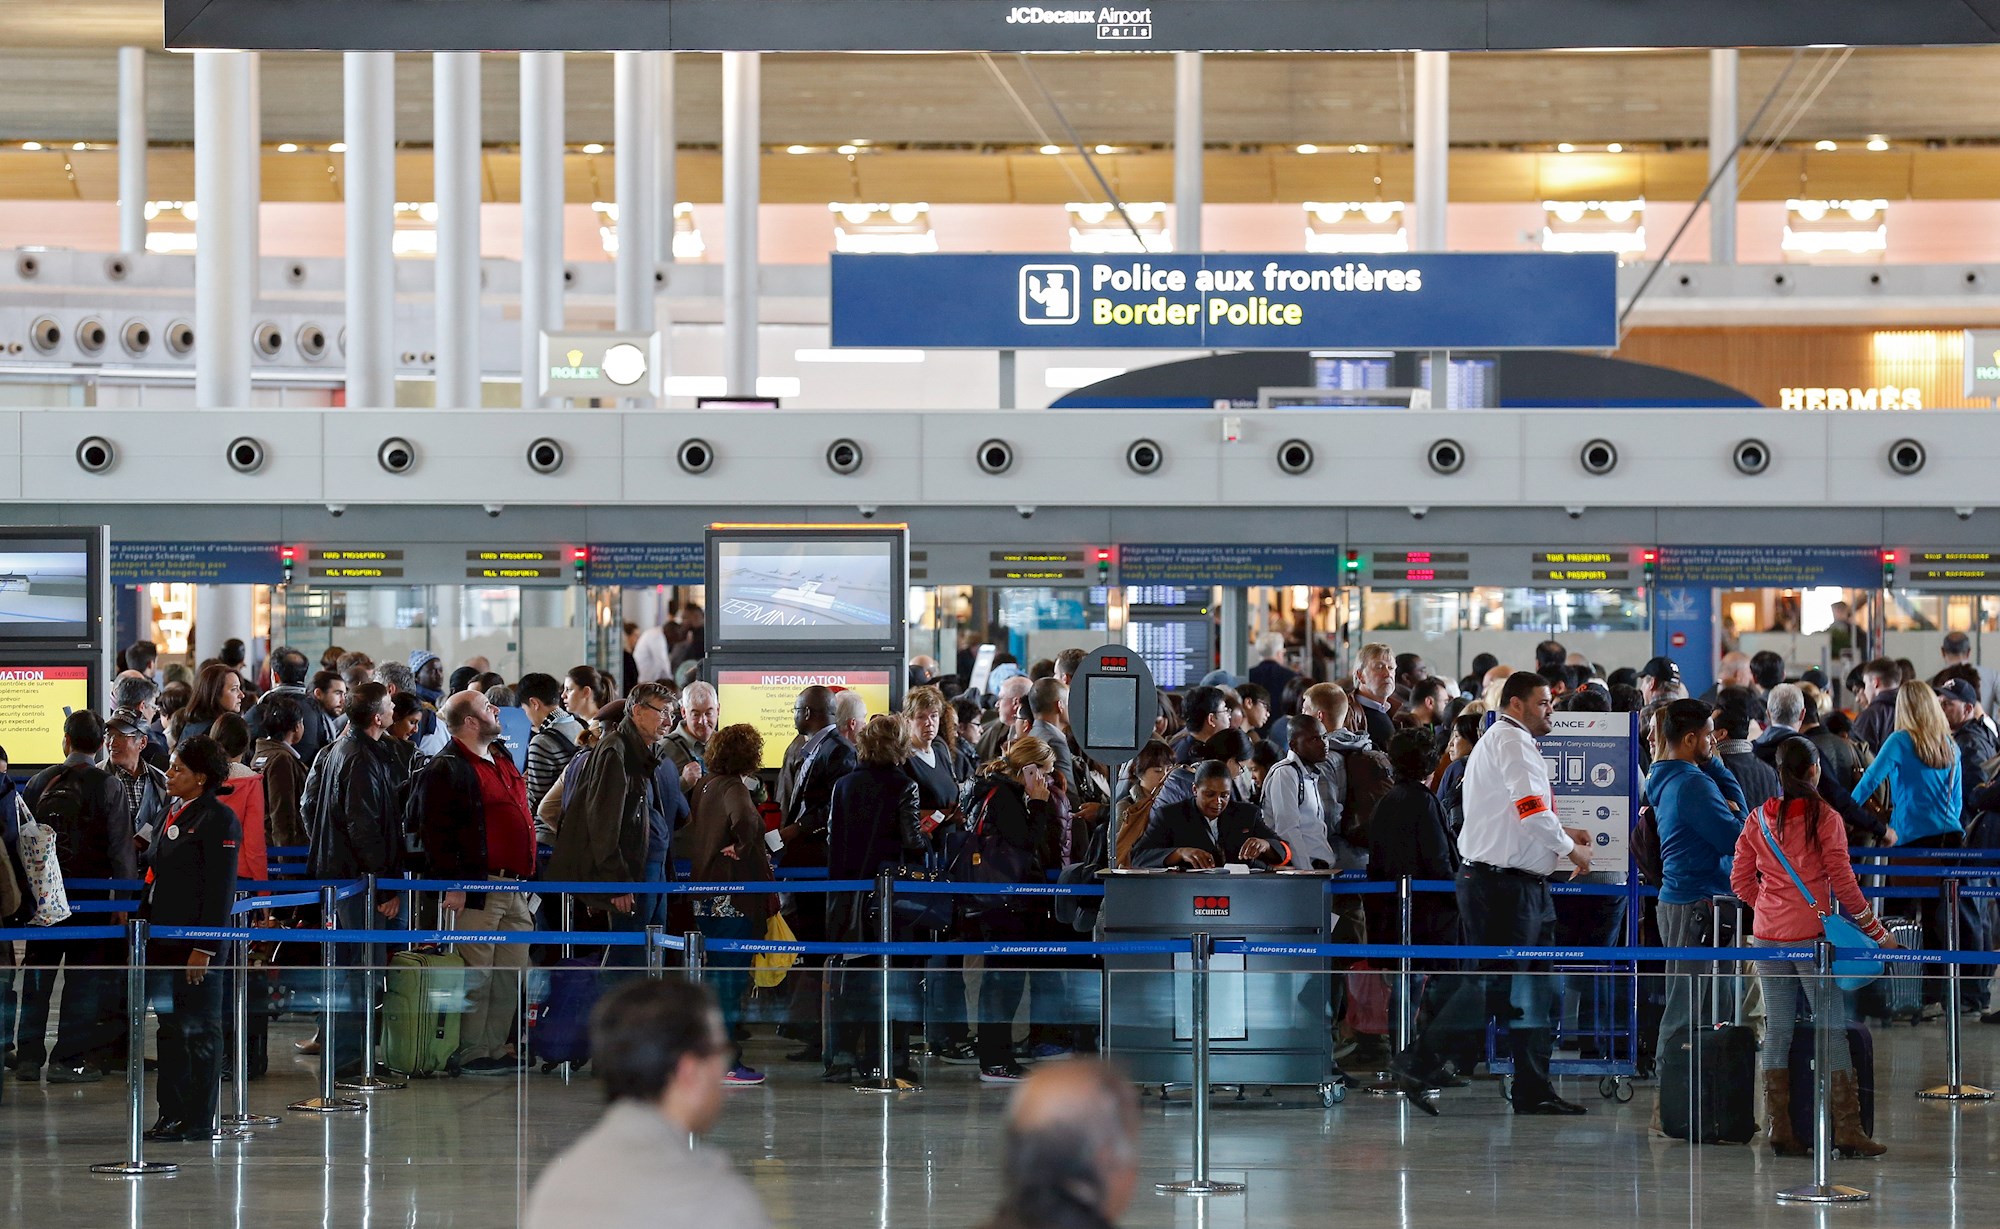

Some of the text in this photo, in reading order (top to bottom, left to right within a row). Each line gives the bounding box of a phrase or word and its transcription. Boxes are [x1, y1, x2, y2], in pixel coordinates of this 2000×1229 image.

[1006, 7, 1152, 24] JCDecaux Airport
[1101, 26, 1148, 36] Paris
[1092, 262, 1422, 292] Police aux frontières
[1092, 298, 1302, 325] Border Police
[550, 366, 600, 378] ROLEX
[0, 671, 44, 680] MATION
[761, 676, 846, 684] INFORMATION
